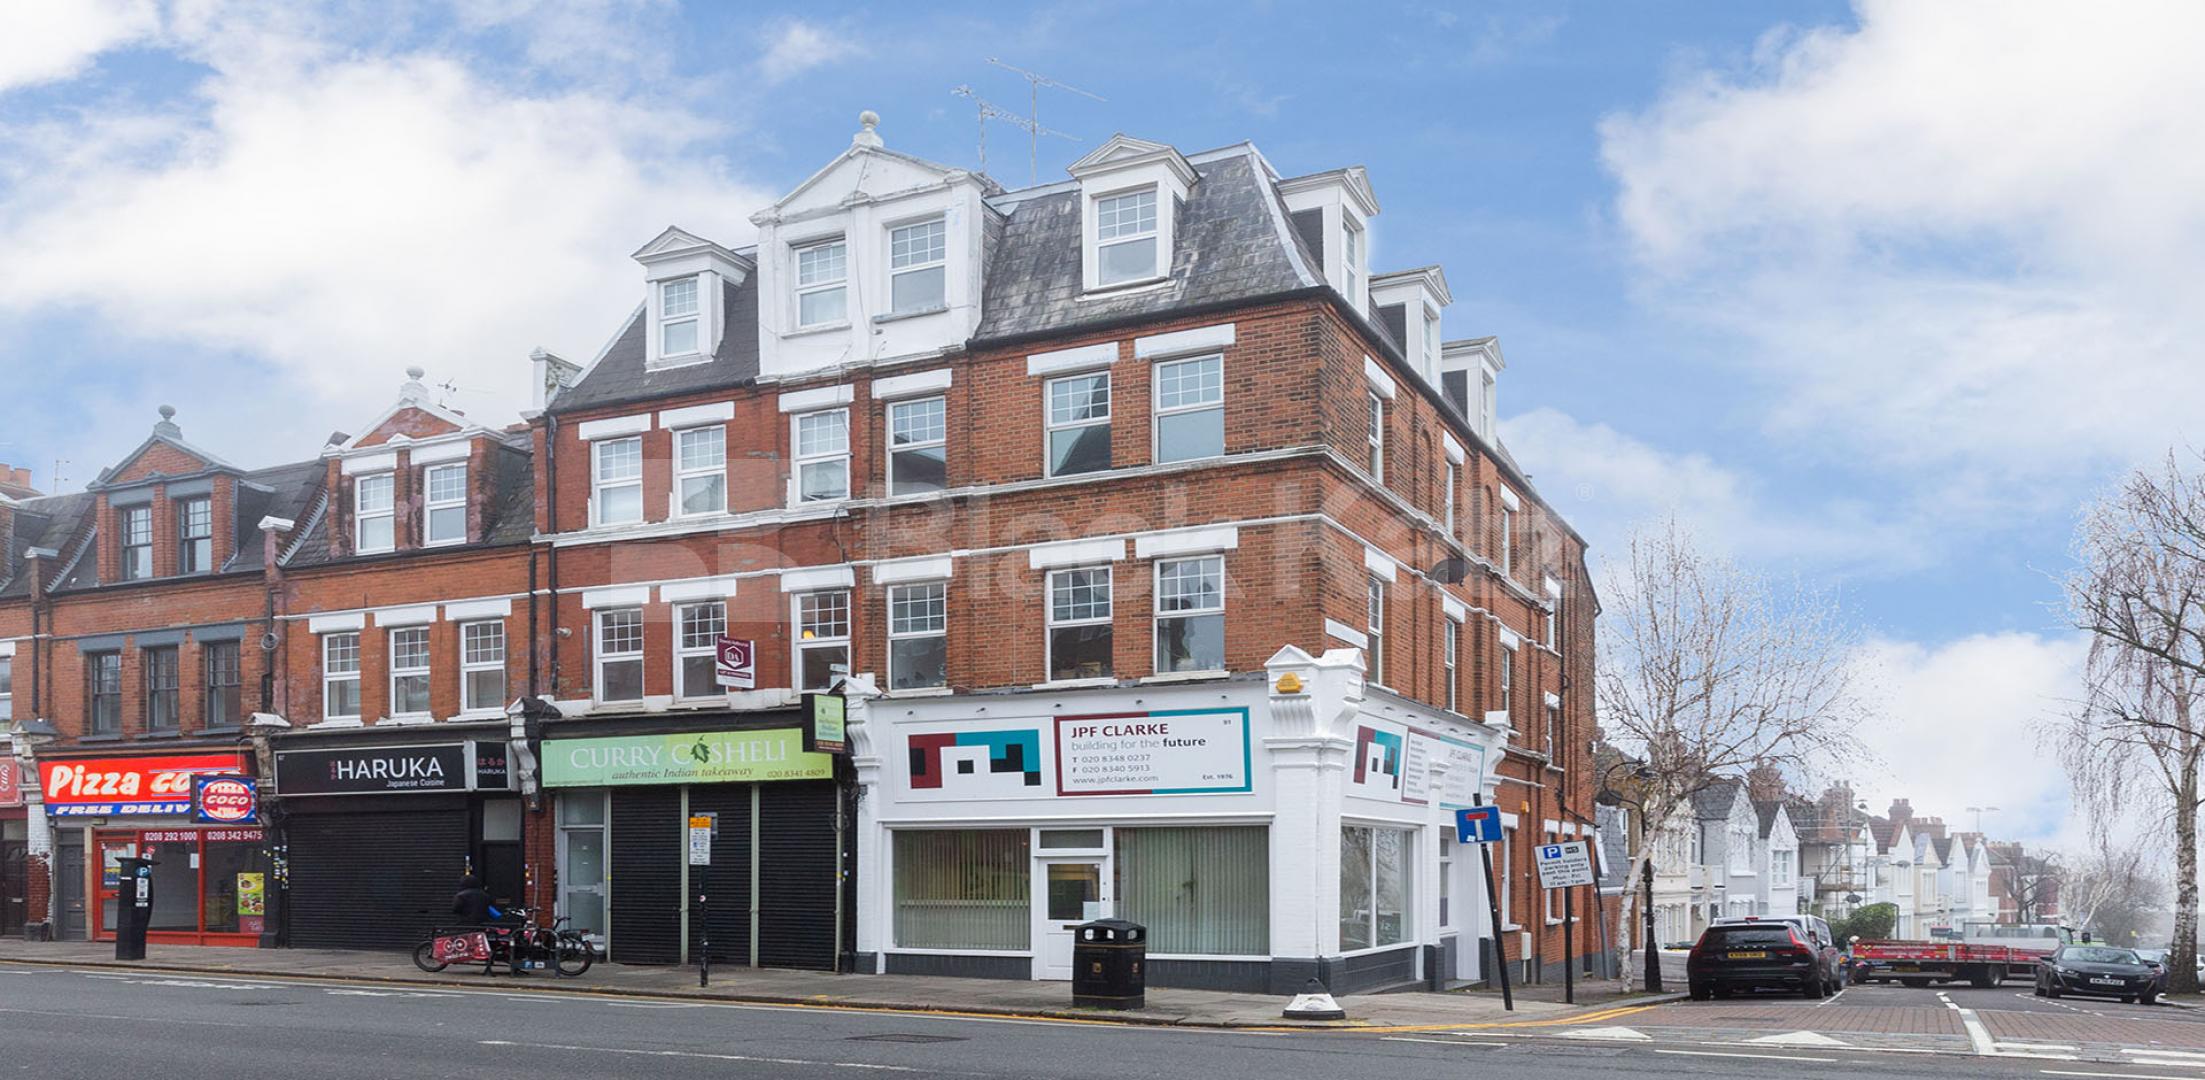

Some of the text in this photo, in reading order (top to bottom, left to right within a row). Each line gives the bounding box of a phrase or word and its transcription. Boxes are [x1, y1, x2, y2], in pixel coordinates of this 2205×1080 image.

[1071, 723, 1169, 739] JPF CLARKE
[1071, 737, 1207, 752] building for the future
[570, 745, 662, 769] CURRY
[1127, 754, 1151, 762] 0237
[337, 757, 444, 780] HARUKA
[611, 766, 754, 780] authentic Indian takeaway
[1081, 766, 1100, 774] 020
[1127, 764, 1151, 772] 5913
[48, 764, 141, 798] Pizza
[386, 778, 445, 788] Japanese Cuisine
[1072, 774, 1159, 784] www.jpfclarke.com
[209, 782, 245, 794] PIZZA
[55, 805, 113, 815] FREE
[227, 831, 241, 840] 342
